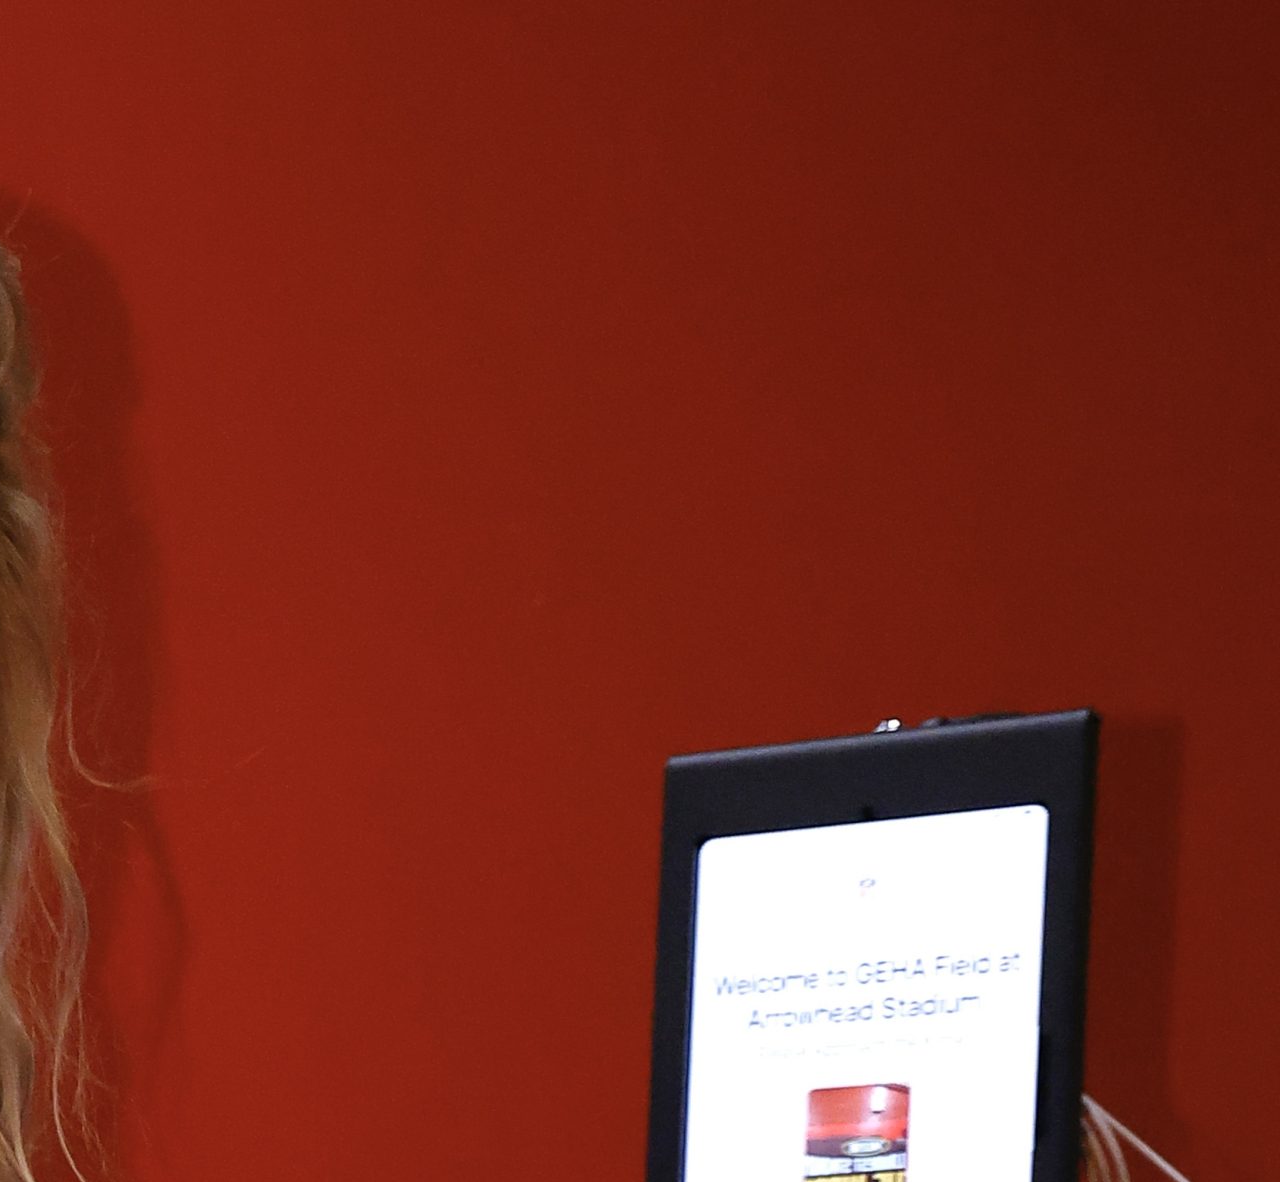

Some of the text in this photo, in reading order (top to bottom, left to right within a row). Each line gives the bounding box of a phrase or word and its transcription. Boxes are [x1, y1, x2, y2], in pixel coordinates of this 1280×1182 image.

[715, 952, 1020, 996] Welcome to GEHA Field at
[749, 993, 980, 1028] Arrowhead Stadium
